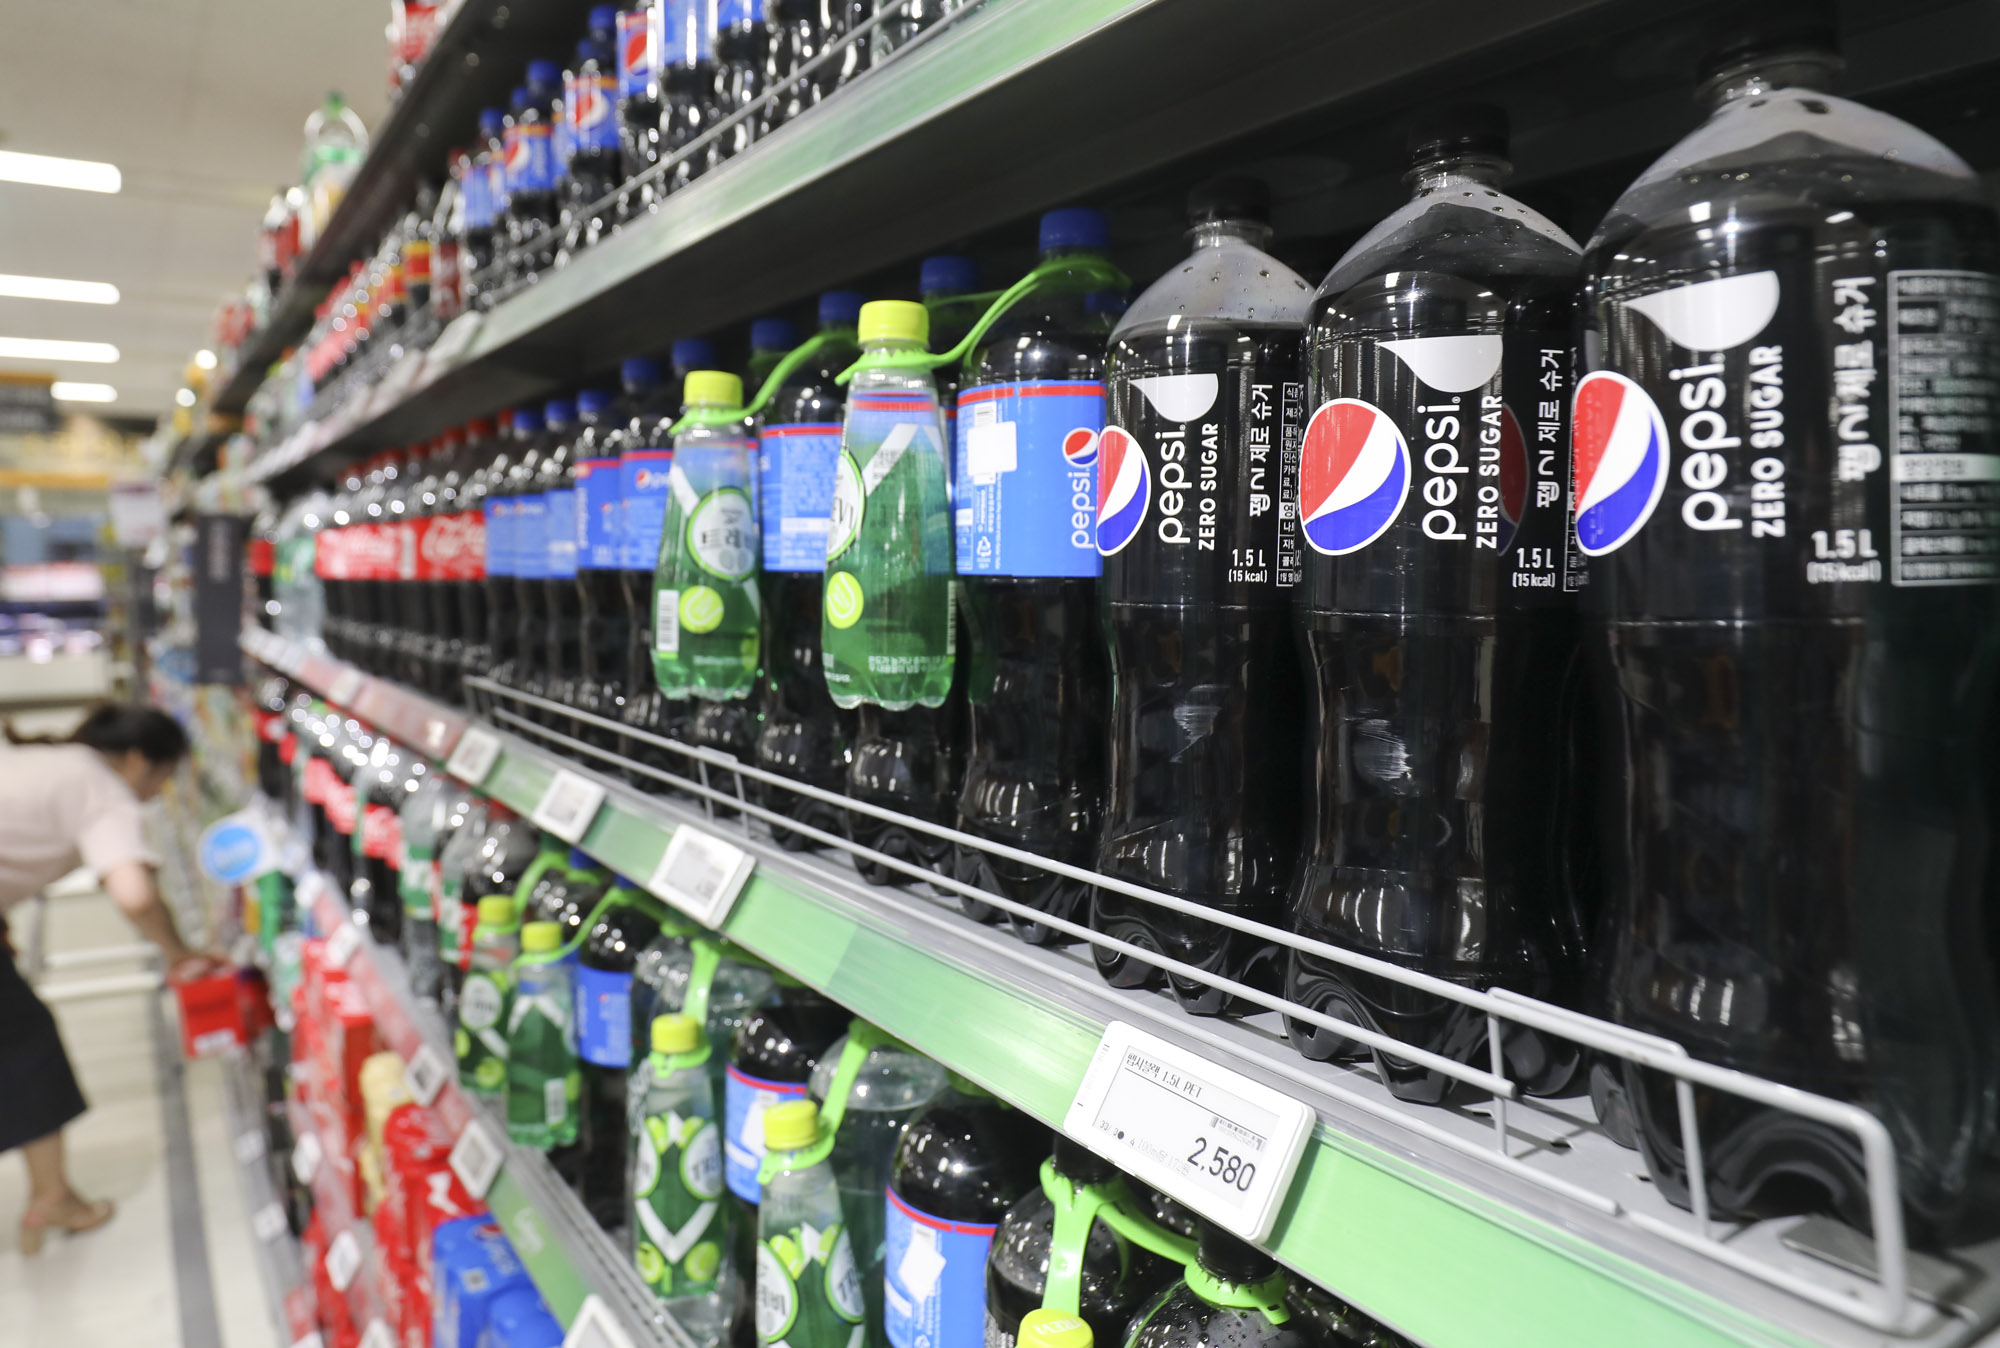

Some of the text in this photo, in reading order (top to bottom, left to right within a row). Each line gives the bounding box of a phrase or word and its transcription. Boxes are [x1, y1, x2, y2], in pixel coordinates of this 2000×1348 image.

[1831, 276, 1877, 334] 슈거
[1249, 384, 1274, 517] 펩시 제로 슈거
[1416, 404, 1470, 541] pepsi
[1475, 395, 1503, 549] ZERO SUGAR
[1536, 349, 1564, 509] 펩시 제로 슈거
[1668, 362, 1744, 532] pepsi
[1748, 344, 1786, 539] ZERO SUGAR
[1837, 404, 1881, 481] 펩시
[1067, 471, 1096, 549] pepsi
[1154, 431, 1193, 544] pepsi
[1198, 423, 1219, 551] ZERO SUGAR
[1228, 569, 1268, 583] (15 kcal)
[1512, 573, 1555, 588] (15 kcal)
[1183, 1080, 1203, 1098] PET
[1186, 1136, 1256, 1192] 2,580
